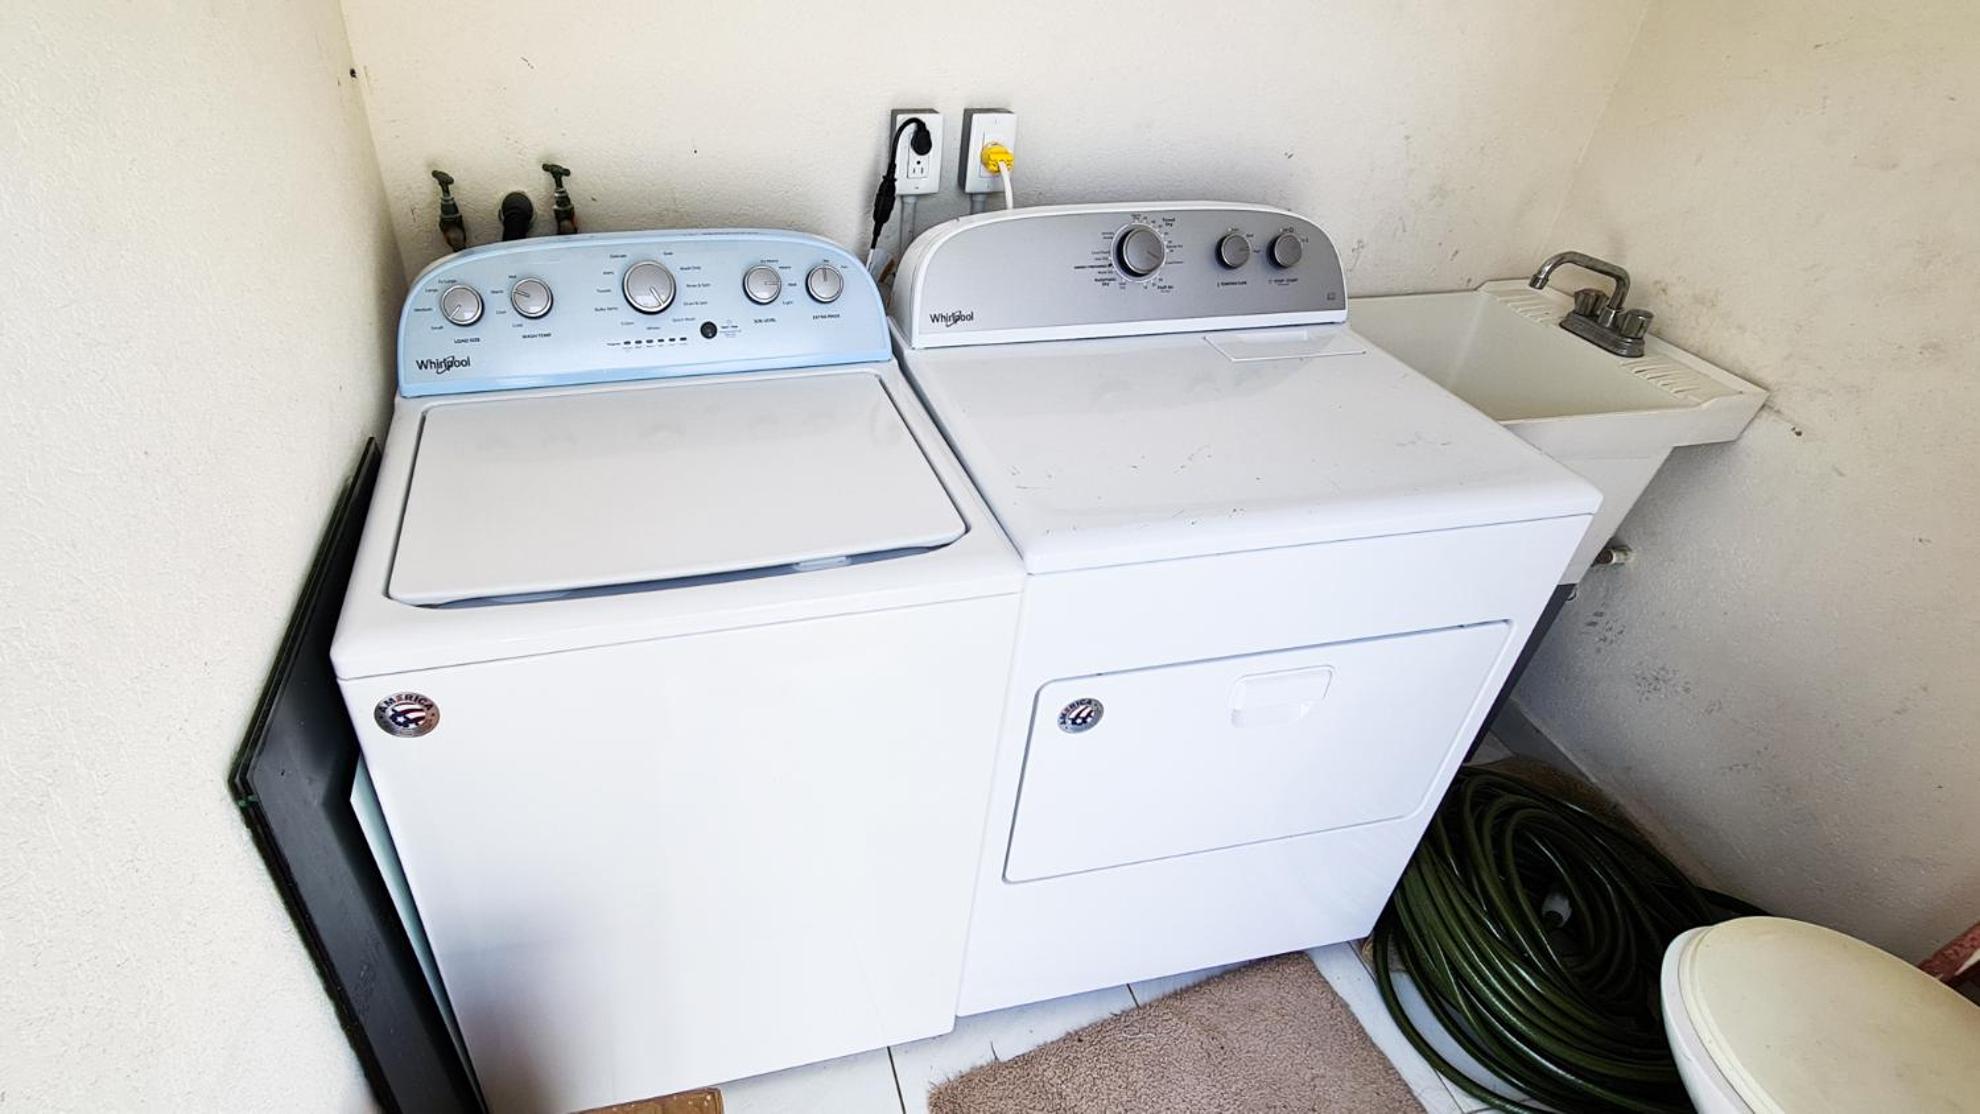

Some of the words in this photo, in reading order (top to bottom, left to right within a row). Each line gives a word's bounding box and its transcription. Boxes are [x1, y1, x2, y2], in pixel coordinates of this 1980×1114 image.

[929, 310, 974, 328] Whirlpool
[416, 356, 471, 374] Whirlpool
[378, 694, 433, 713] AMERICA
